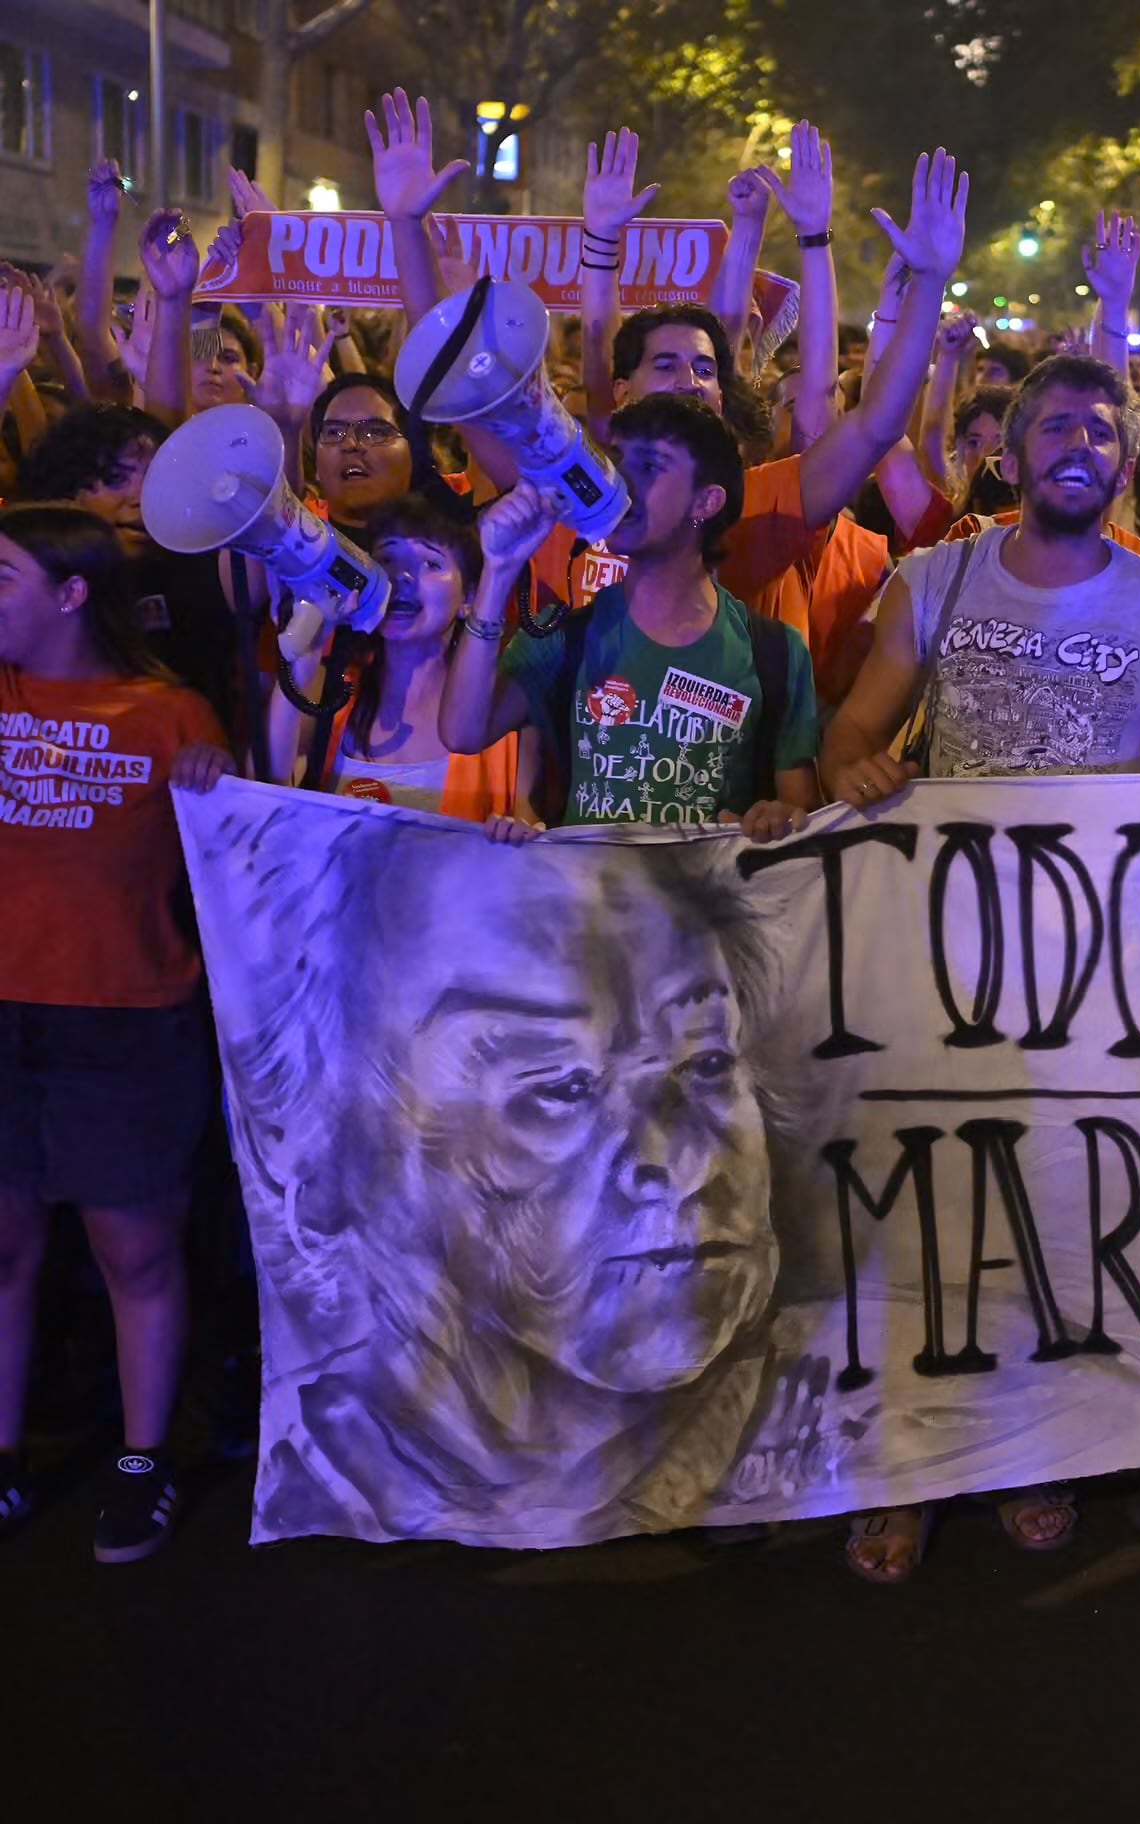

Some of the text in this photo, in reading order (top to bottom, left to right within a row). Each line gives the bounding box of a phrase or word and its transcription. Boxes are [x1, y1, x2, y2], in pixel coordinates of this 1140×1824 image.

[663, 684, 742, 724] REVOLUCIONARIA
[667, 671, 731, 706] IZQUIERDA
[594, 753, 626, 779] DE
